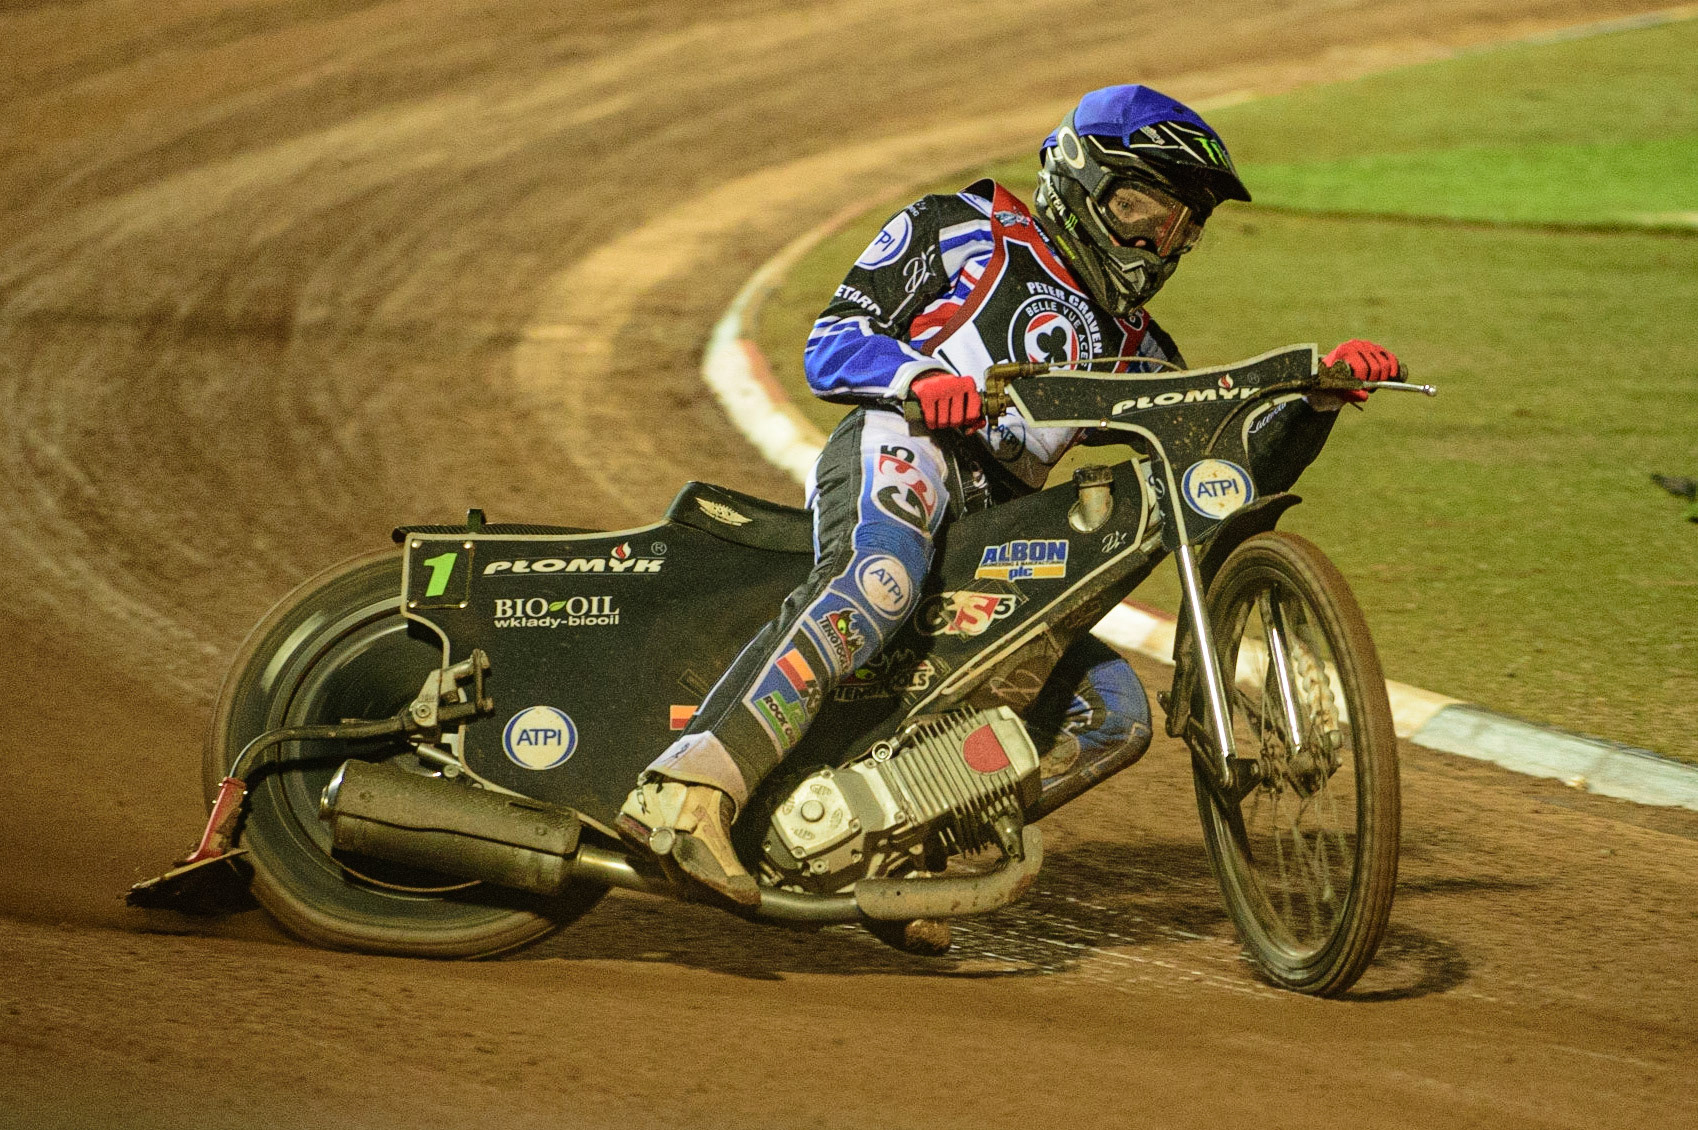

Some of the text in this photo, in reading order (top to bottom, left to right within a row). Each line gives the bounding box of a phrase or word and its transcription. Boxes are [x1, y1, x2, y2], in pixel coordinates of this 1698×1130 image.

[874, 230, 896, 252] PI
[1025, 300, 1057, 317] BELLE
[1062, 306, 1082, 329] VUE
[1026, 281, 1066, 300] PETER
[1068, 294, 1103, 354] CRAVEN
[1196, 478, 1239, 498] ATPI
[981, 541, 1067, 566] ALBON
[423, 552, 458, 597] 1
[870, 567, 903, 604] ATPI
[1009, 566, 1033, 580] plc
[493, 615, 620, 629] wkłady-biooil
[763, 695, 788, 726] ROCK
[516, 728, 562, 746] ATPI
